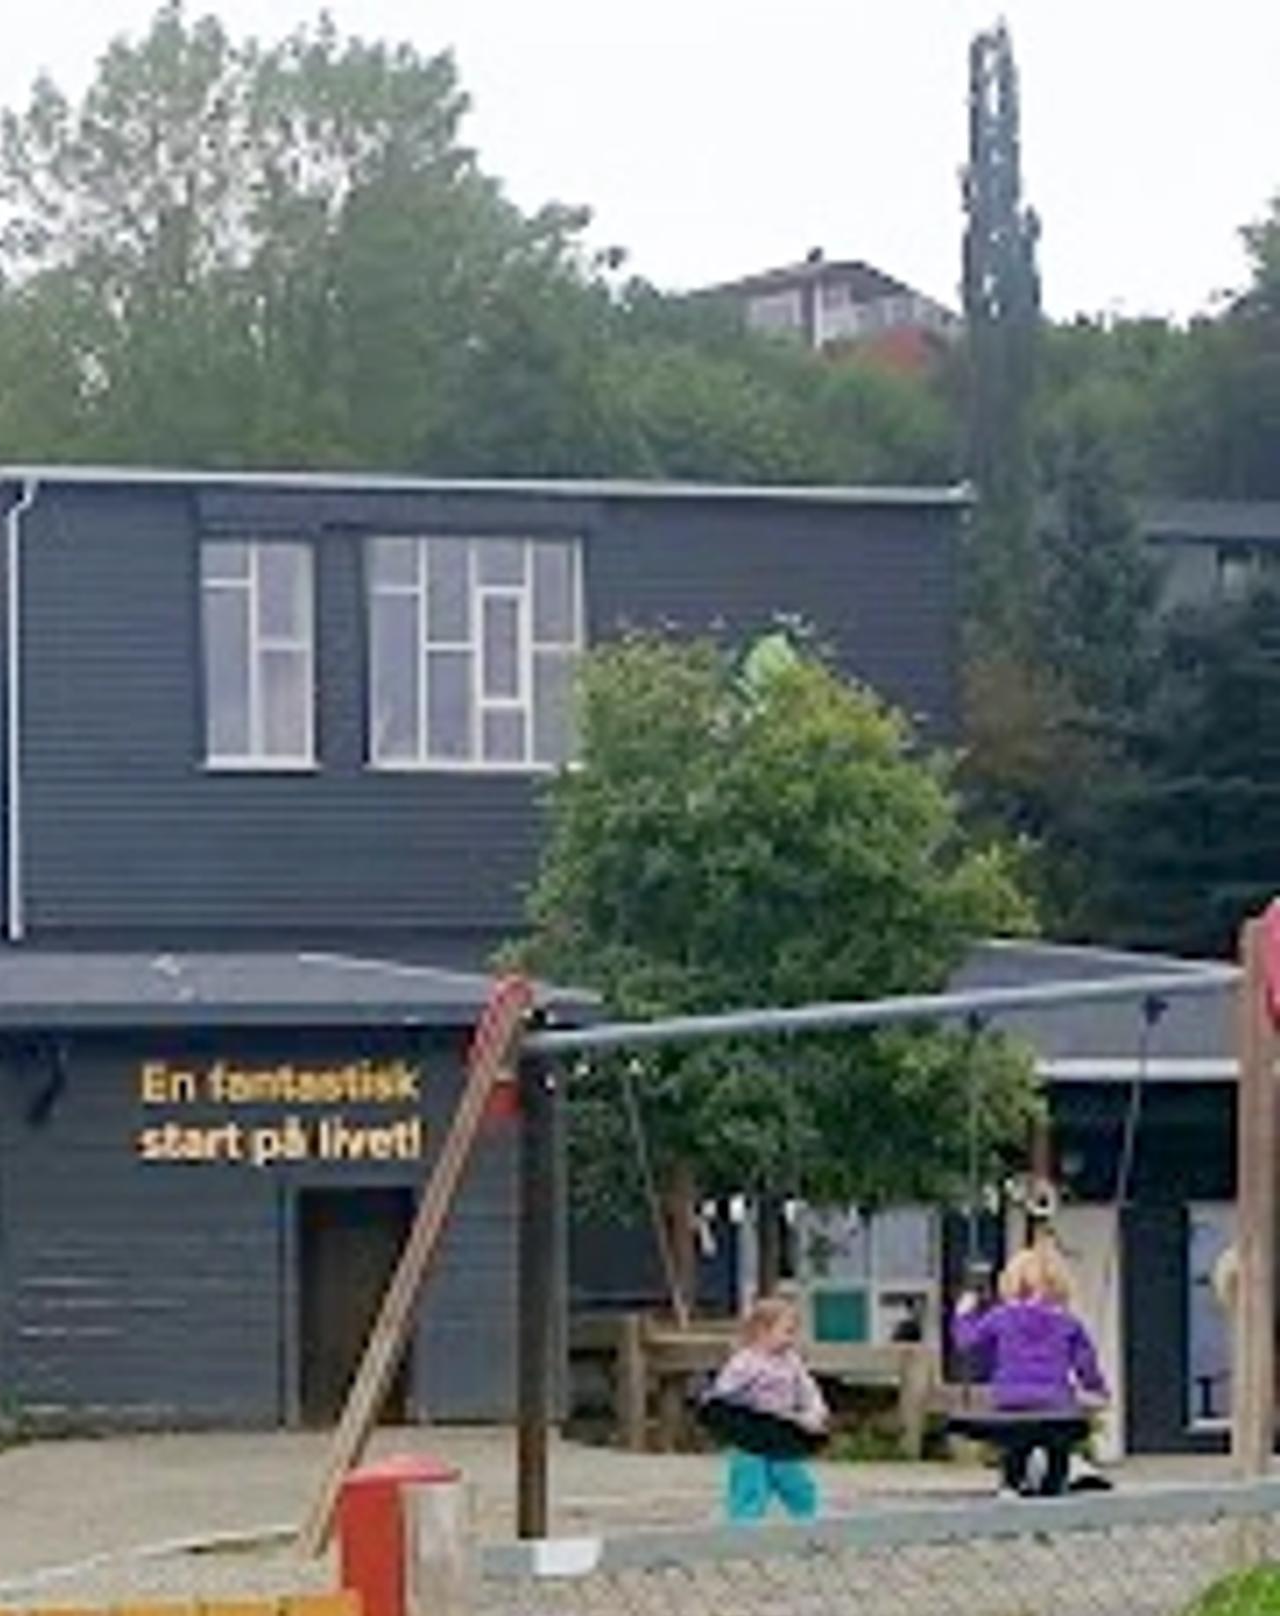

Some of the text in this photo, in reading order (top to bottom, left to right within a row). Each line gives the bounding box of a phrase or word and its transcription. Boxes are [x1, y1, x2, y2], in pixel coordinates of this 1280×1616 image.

[141, 1058, 420, 1103] En fantastisk
[140, 1120, 243, 1160] start
[253, 1112, 307, 1167] på
